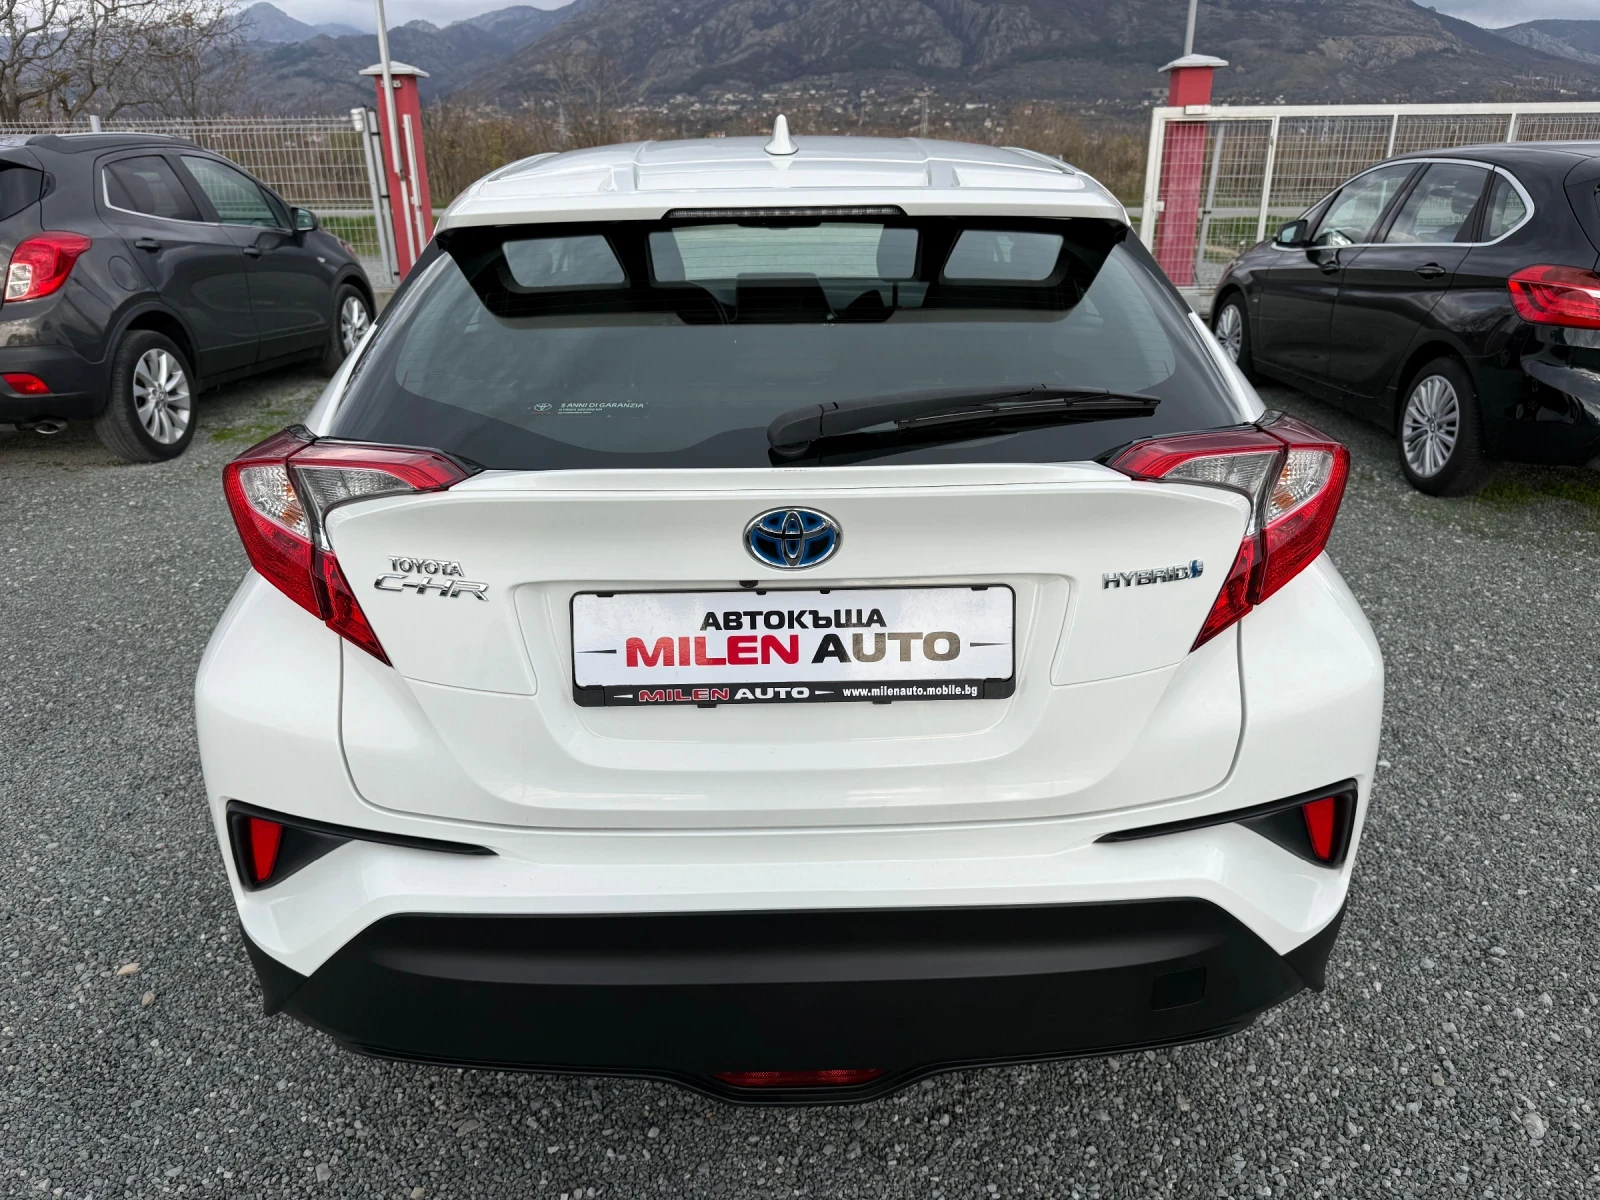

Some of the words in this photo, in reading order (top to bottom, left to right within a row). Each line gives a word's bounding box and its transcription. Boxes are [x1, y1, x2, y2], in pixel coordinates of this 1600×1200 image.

[388, 555, 465, 577] TOYOTA
[1101, 564, 1188, 590] HYBRID
[374, 573, 489, 602] C-HR
[626, 634, 800, 668] MILEN
[811, 631, 961, 664] AUTO
[638, 688, 730, 702] MILEN
[734, 687, 810, 700] AUTO
[843, 685, 978, 698] www.milenauto.mobile.bg
